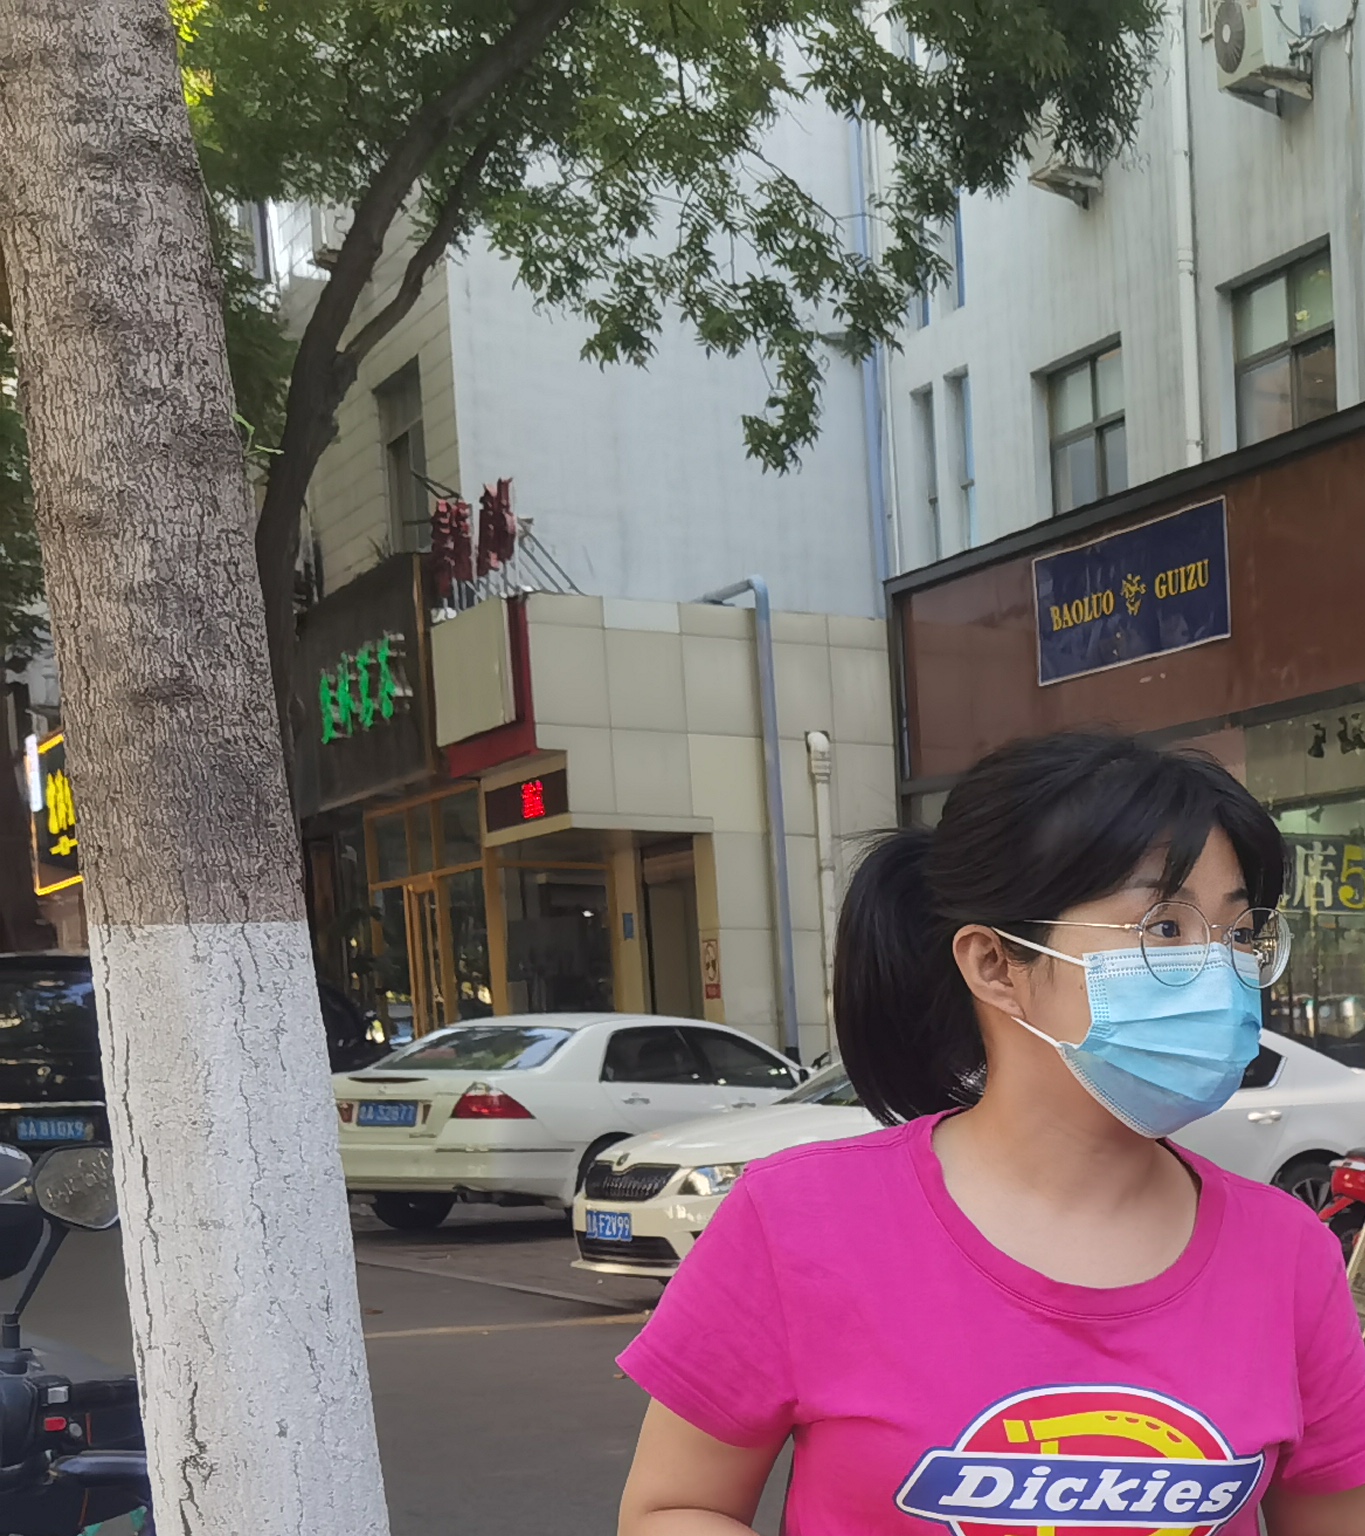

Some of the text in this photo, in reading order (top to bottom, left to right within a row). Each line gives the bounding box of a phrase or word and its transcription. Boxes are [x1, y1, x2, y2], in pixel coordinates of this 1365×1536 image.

[1050, 559, 1209, 632] BAOLUO GUIZU
[938, 1465, 1243, 1513] Dickies
